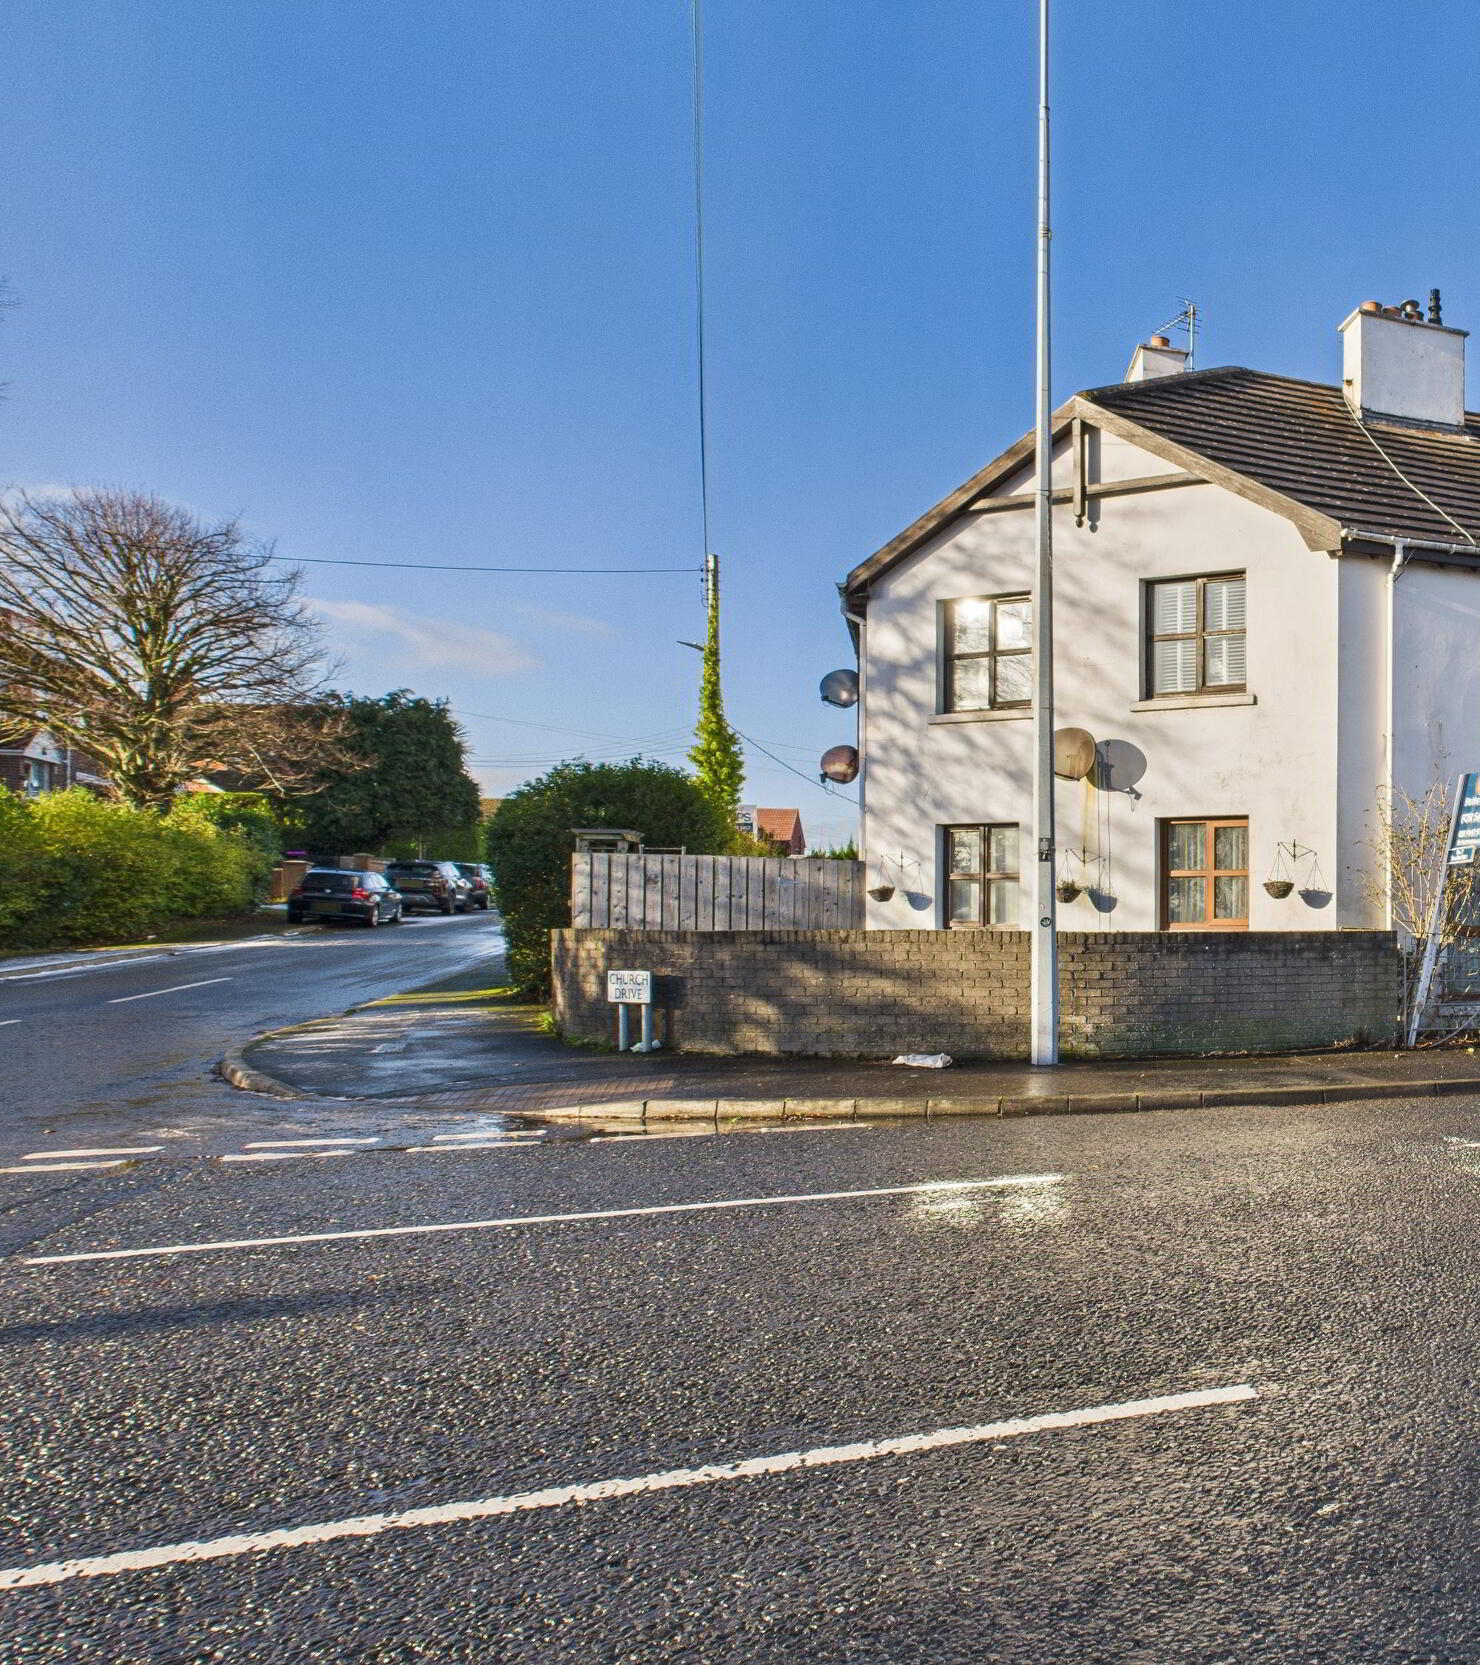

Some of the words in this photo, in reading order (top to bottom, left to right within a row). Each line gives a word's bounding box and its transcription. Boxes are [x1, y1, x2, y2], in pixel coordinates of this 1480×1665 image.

[736, 812, 752, 822] PS
[610, 973, 648, 985] CHURCH
[615, 988, 642, 999] DRIVE
